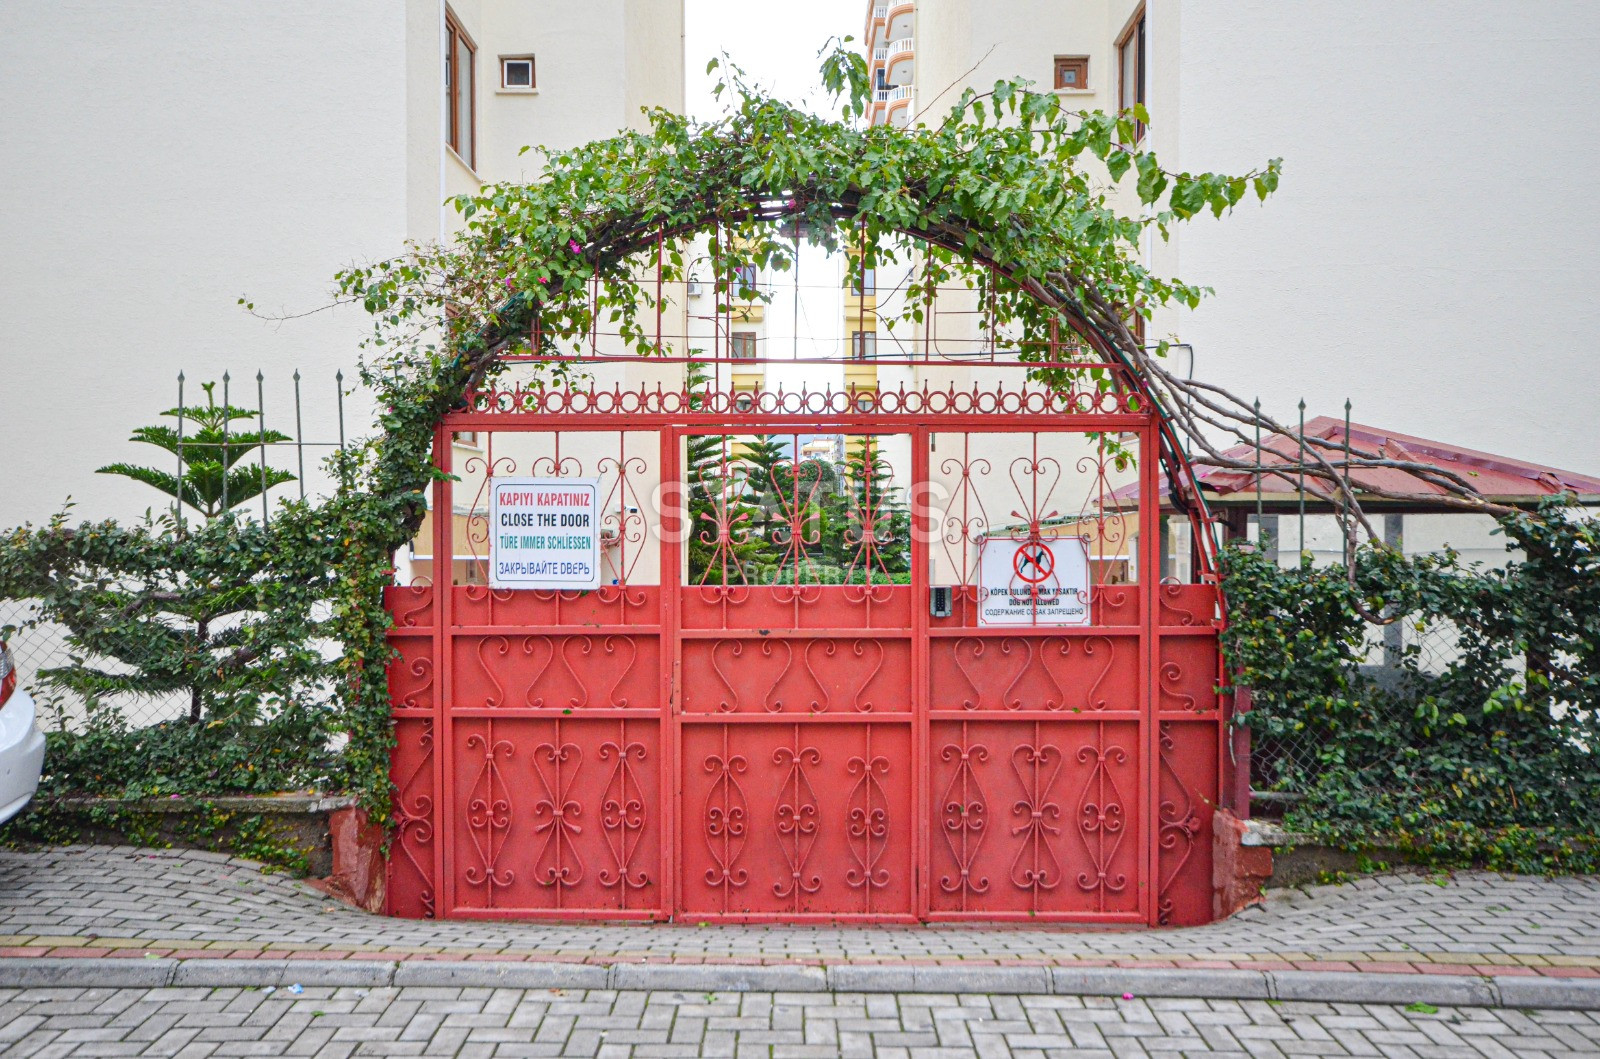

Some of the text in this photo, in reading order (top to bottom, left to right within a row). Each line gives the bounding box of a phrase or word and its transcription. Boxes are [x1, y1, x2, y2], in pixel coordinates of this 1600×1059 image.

[499, 492, 590, 506] KAPIYI KAPATINIZ
[501, 513, 590, 527] CLOSE THE DOOR
[499, 533, 518, 549] TÜRE
[520, 535, 545, 549] IMMER
[499, 560, 558, 575] ЗАКРЫВАЙТЕ
[990, 587, 1008, 596] KÖPEK
[1009, 598, 1020, 606] DOG
[1022, 598, 1032, 606] NOT
[985, 608, 1025, 616] СОДЕРЖАНИЕ
[1047, 607, 1084, 616] ЗАПРЕЩЕНО
